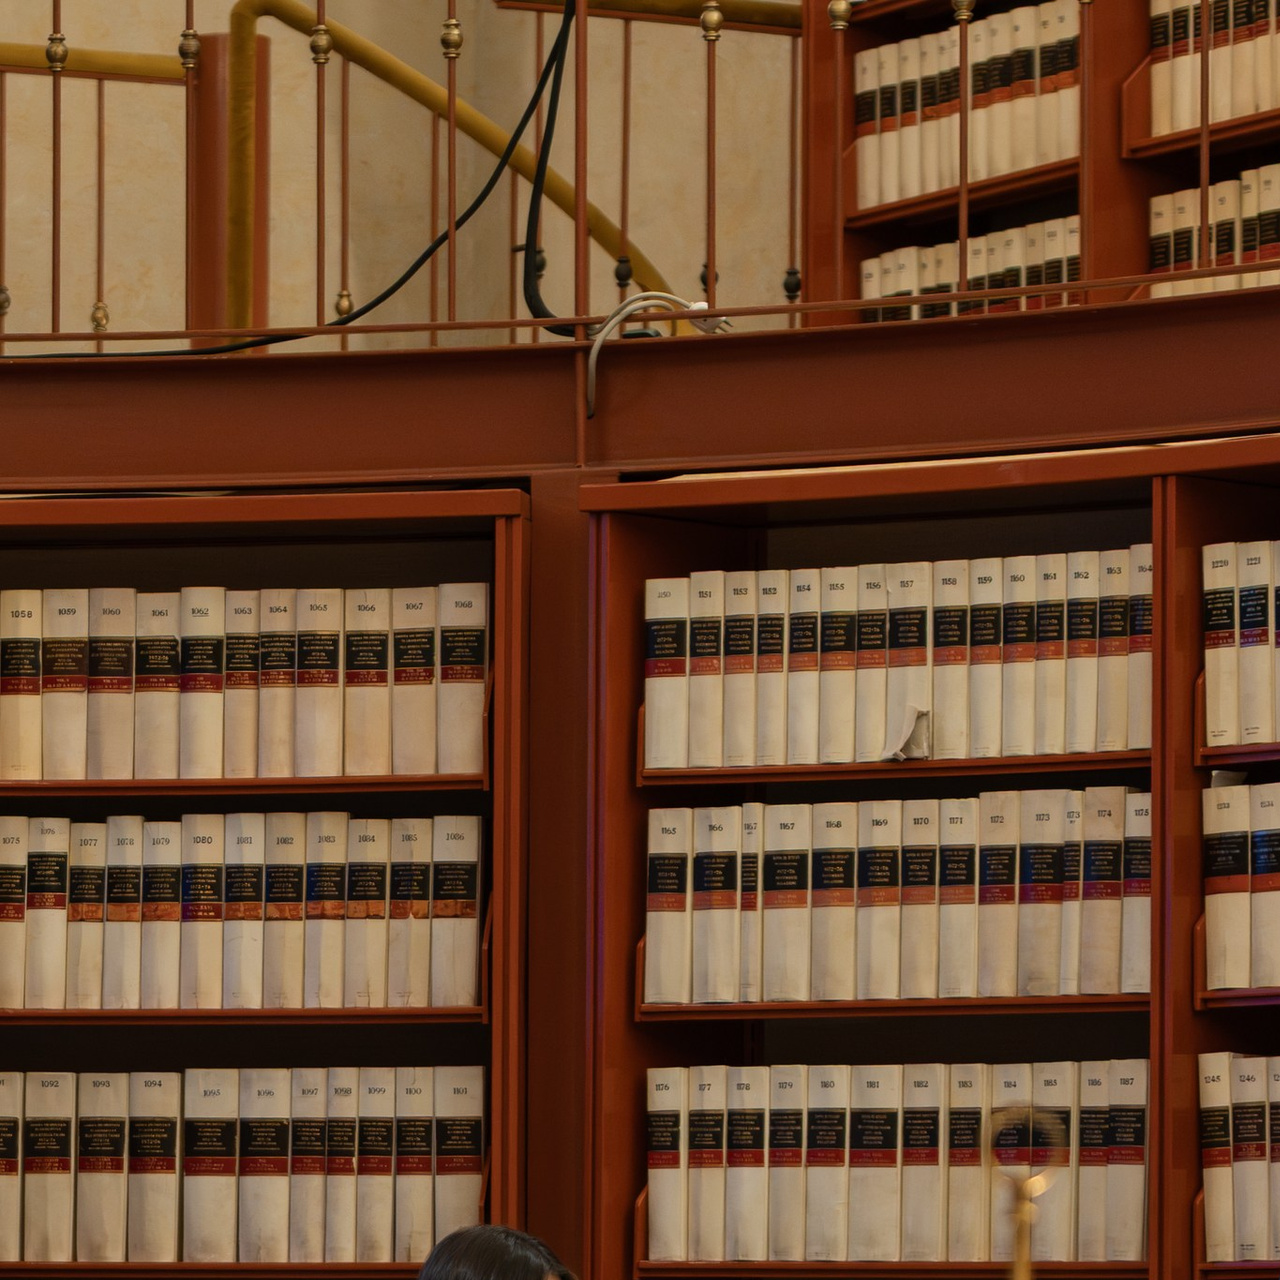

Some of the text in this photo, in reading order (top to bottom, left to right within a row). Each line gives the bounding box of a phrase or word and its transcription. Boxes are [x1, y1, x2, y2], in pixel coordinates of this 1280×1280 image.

[1107, 567, 1122, 575] 1163
[1010, 575, 1026, 583] 1160
[1044, 573, 1057, 581] 1161
[1074, 572, 1090, 580] 1162
[900, 580, 915, 588] 1157
[942, 578, 958, 586] 1158
[978, 576, 993, 585] 1159
[797, 585, 812, 593] 1154
[866, 582, 882, 590] 1156
[699, 591, 712, 599] 1151
[733, 588, 749, 596] 1153
[310, 604, 328, 612] 1065
[406, 603, 424, 611] 1067
[455, 601, 473, 609] 1068
[59, 608, 77, 616] 1059
[102, 608, 122, 616] 1060
[192, 608, 210, 617] 1062
[234, 607, 253, 615] 1063
[270, 606, 288, 614] 1064
[11, 610, 33, 619] 1058
[1098, 810, 1113, 818] 1174
[1135, 809, 1150, 817] 1175
[913, 818, 930, 826] 1170
[949, 817, 964, 825] 1171
[990, 816, 1005, 824] 1172
[1036, 814, 1051, 822] 1173
[780, 823, 796, 831] 1167
[826, 821, 843, 829] 1168
[872, 819, 889, 827] 1169
[662, 827, 677, 835] 1165
[709, 824, 724, 832] 1166
[3, 837, 21, 845] 1075
[117, 838, 135, 846] 1078
[152, 838, 171, 846] 1079
[194, 836, 213, 845] 1080
[237, 837, 253, 845] 1081
[277, 837, 295, 846] 1082
[318, 836, 336, 844] 1083
[402, 834, 418, 843] 1085
[80, 839, 98, 847] 1077
[1120, 1078, 1135, 1086] 1187
[1205, 1075, 1221, 1084] 1245
[1240, 1075, 1257, 1083] 1246
[41, 1080, 60, 1088] 1092
[93, 1080, 111, 1088] 1093
[144, 1080, 163, 1088] 1094
[656, 1084, 670, 1092] 1176
[699, 1084, 712, 1092] 1177
[737, 1083, 751, 1091] 1178
[778, 1082, 794, 1090] 1179
[867, 1081, 880, 1089] 1181
[914, 1081, 929, 1089] 1182
[958, 1081, 973, 1089] 1183
[204, 1089, 221, 1098] 1095
[302, 1088, 319, 1096] 1097
[368, 1087, 387, 1095] 1099
[406, 1088, 423, 1096] 1100
